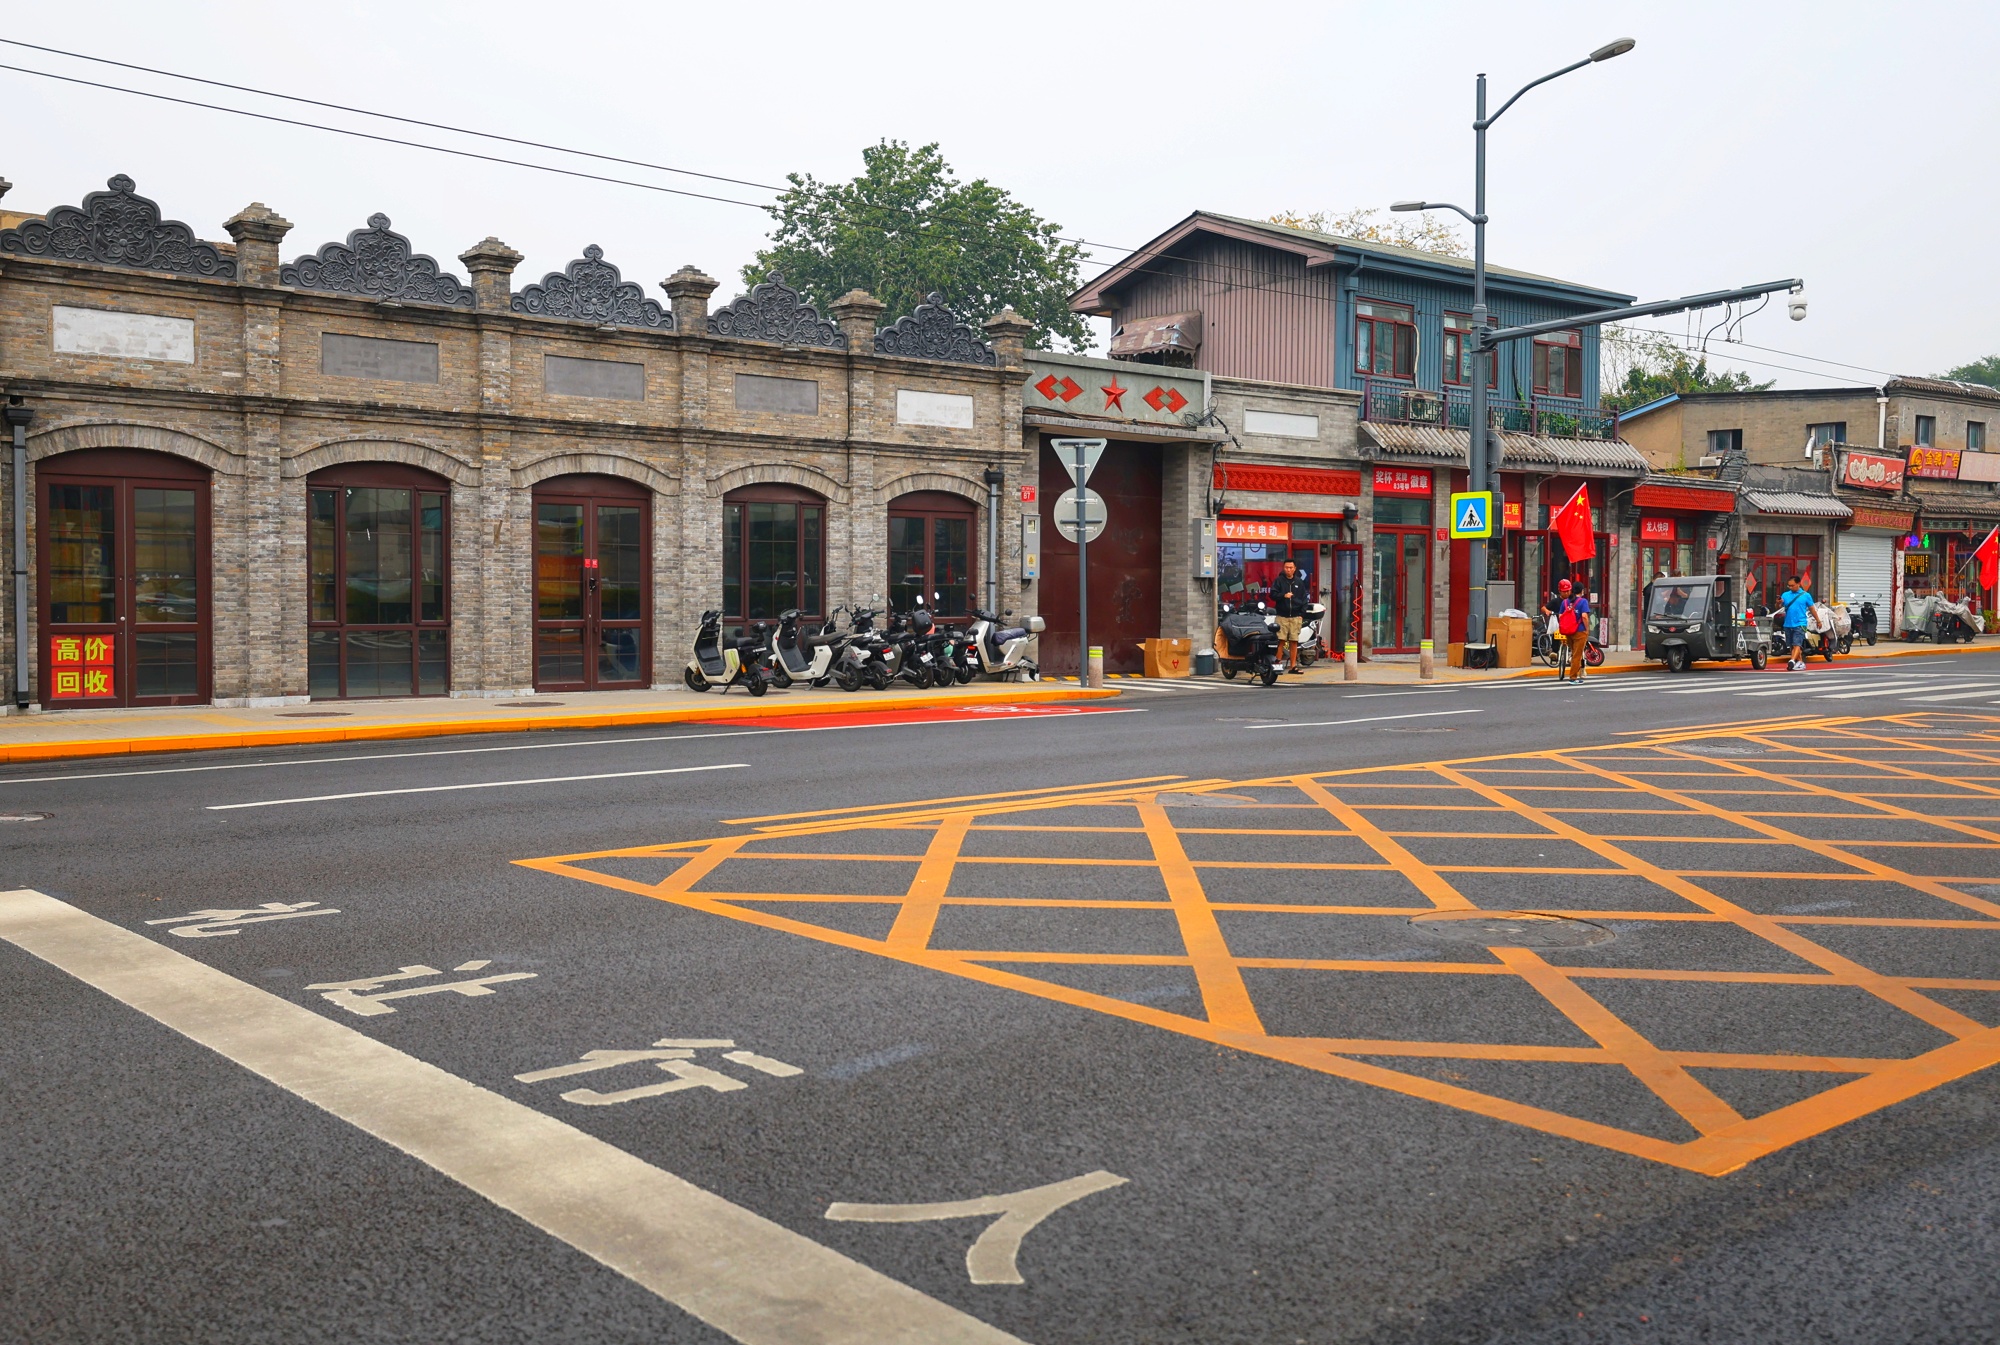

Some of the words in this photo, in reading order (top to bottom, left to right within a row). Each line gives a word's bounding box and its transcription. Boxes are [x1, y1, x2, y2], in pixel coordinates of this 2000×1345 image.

[1376, 471, 1392, 484] 奖杯
[1410, 474, 1428, 489] 徽章
[1236, 524, 1278, 537] 小牛电动
[1646, 521, 1669, 532] 龙人快印
[57, 638, 108, 661] 高价
[57, 671, 108, 693] 回收
